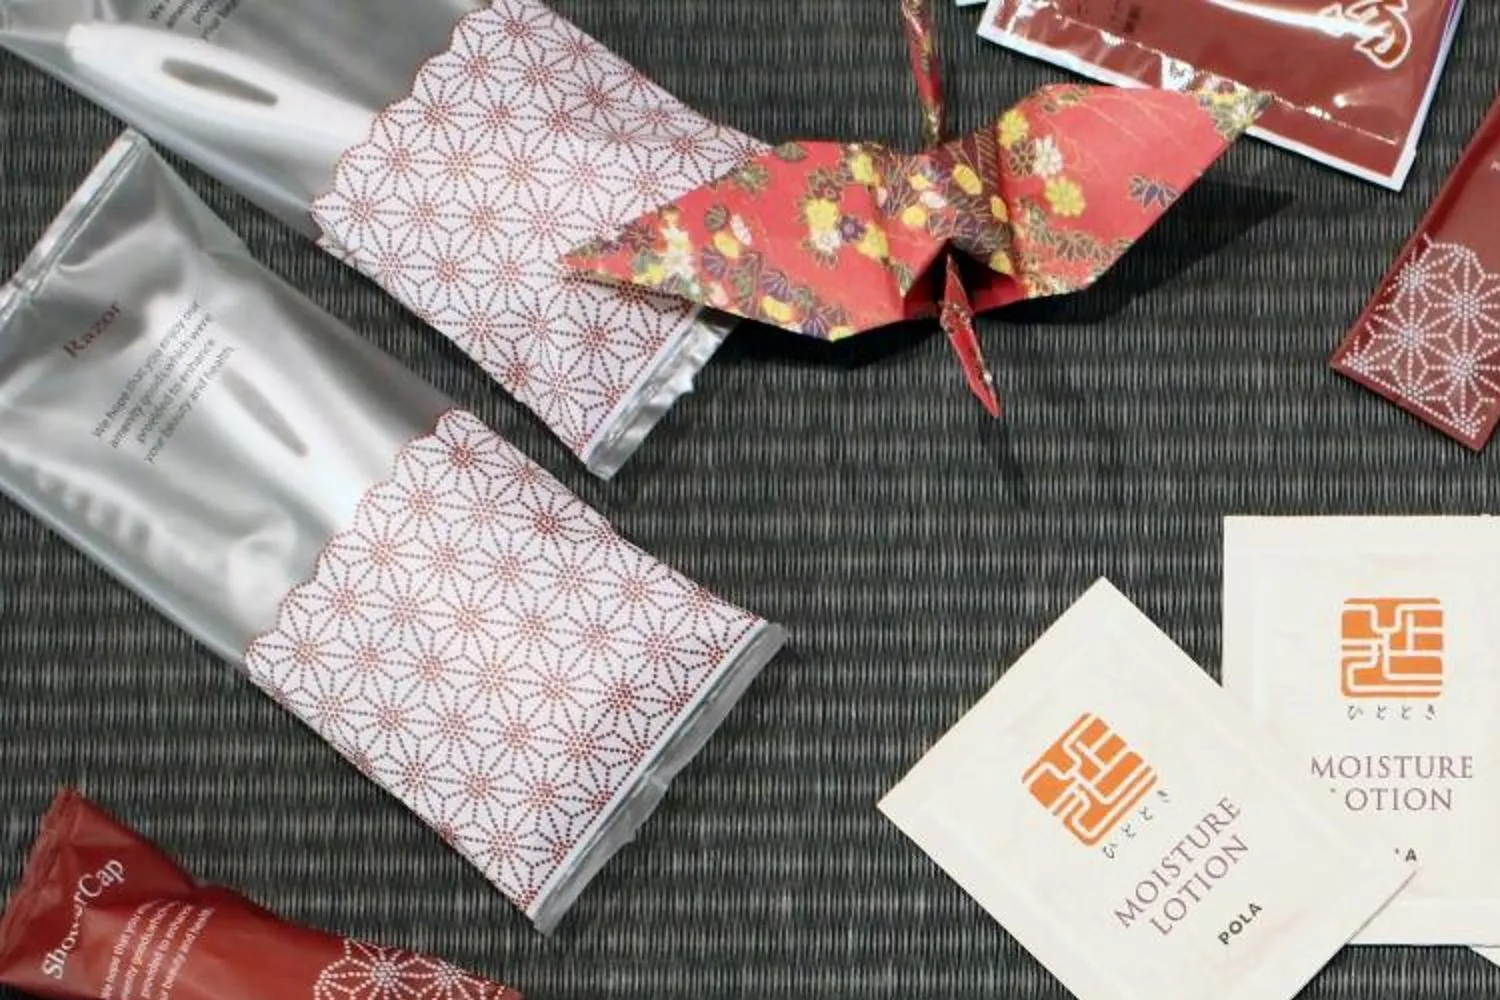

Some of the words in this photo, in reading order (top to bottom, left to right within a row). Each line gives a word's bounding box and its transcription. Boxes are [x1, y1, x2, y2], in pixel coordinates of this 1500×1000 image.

[63, 302, 122, 358] Razor
[1347, 704, 1435, 720] ひととき
[1310, 755, 1473, 779] MOISTURE
[1330, 787, 1453, 811] OTION
[1114, 797, 1241, 928] MOISTURE
[1149, 833, 1249, 936] LOTION
[1218, 902, 1263, 945] POLA
